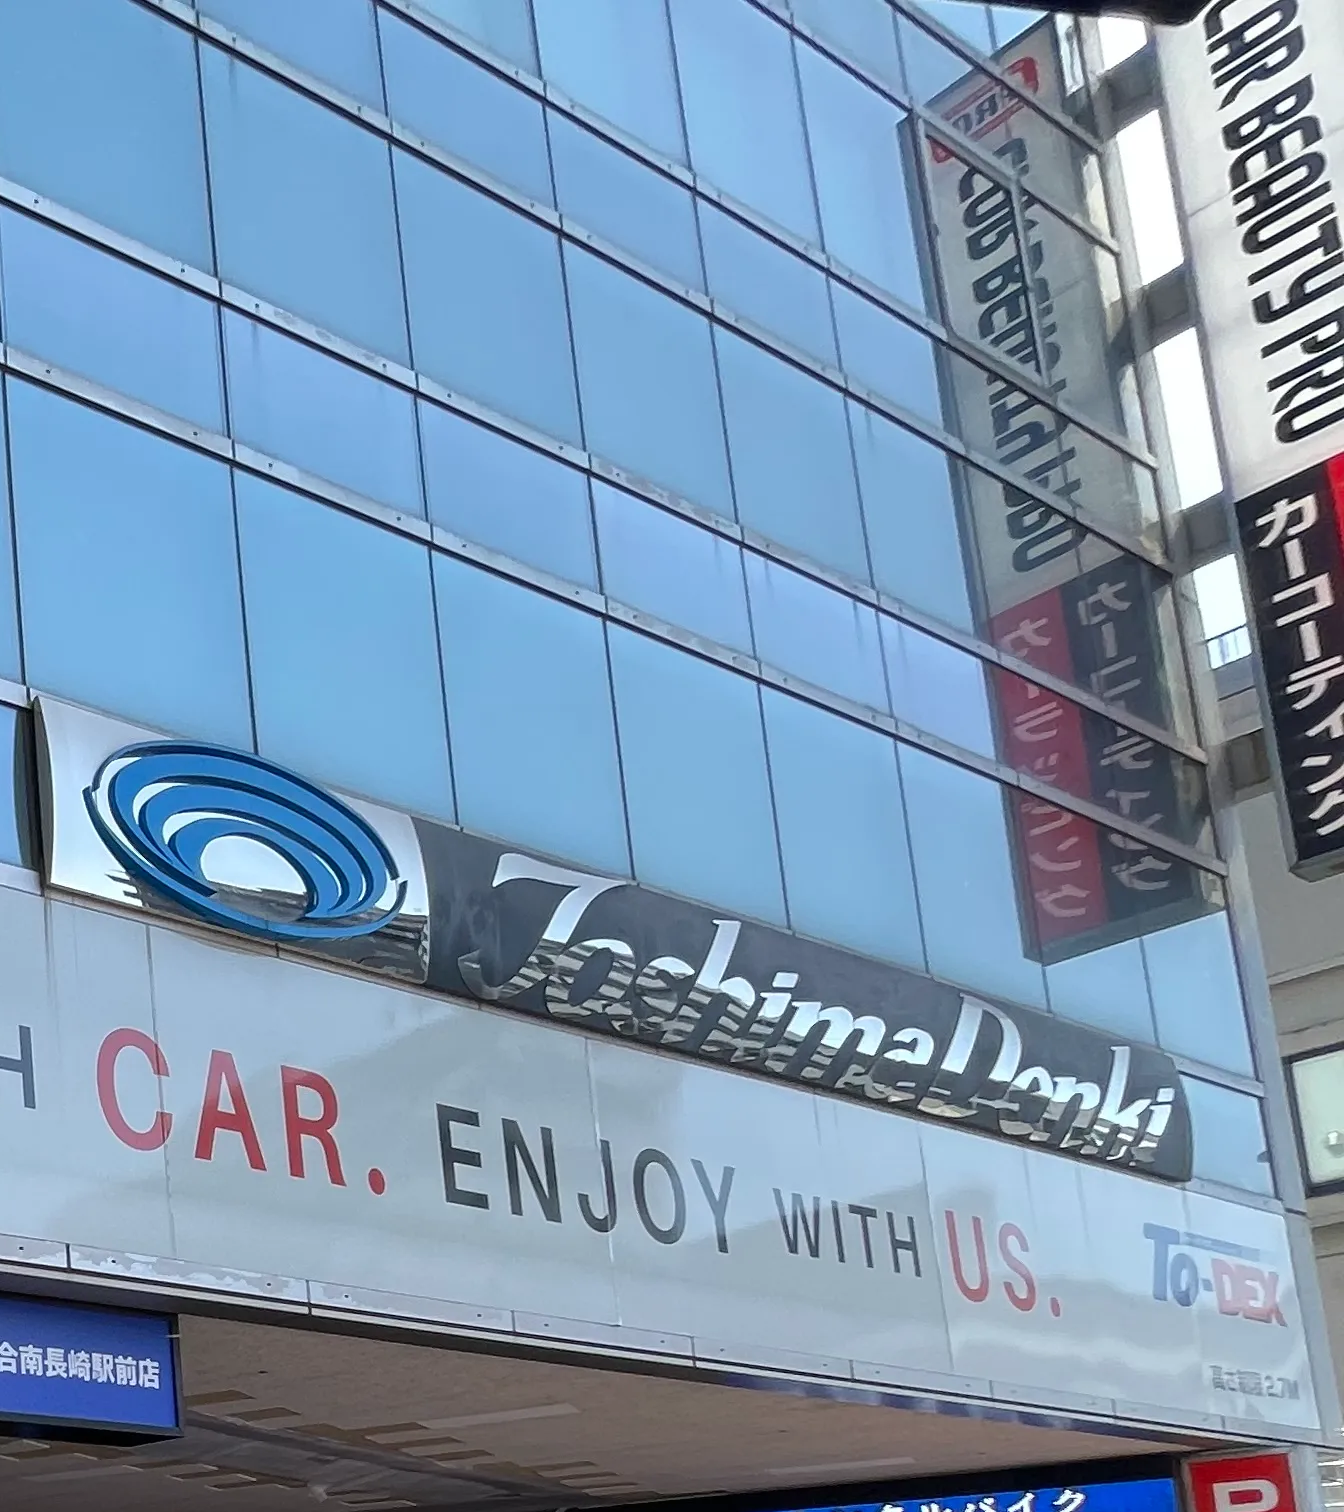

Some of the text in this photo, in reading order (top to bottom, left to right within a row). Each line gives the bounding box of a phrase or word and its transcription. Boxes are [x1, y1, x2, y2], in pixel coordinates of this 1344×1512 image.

[1221, 73, 1344, 324] BEAUTY
[1261, 305, 1344, 443] PRO
[95, 1027, 387, 1196] CAR.
[435, 1103, 737, 1255] ENJOY
[773, 1187, 924, 1279] WITH
[945, 1208, 1064, 1318] US.
